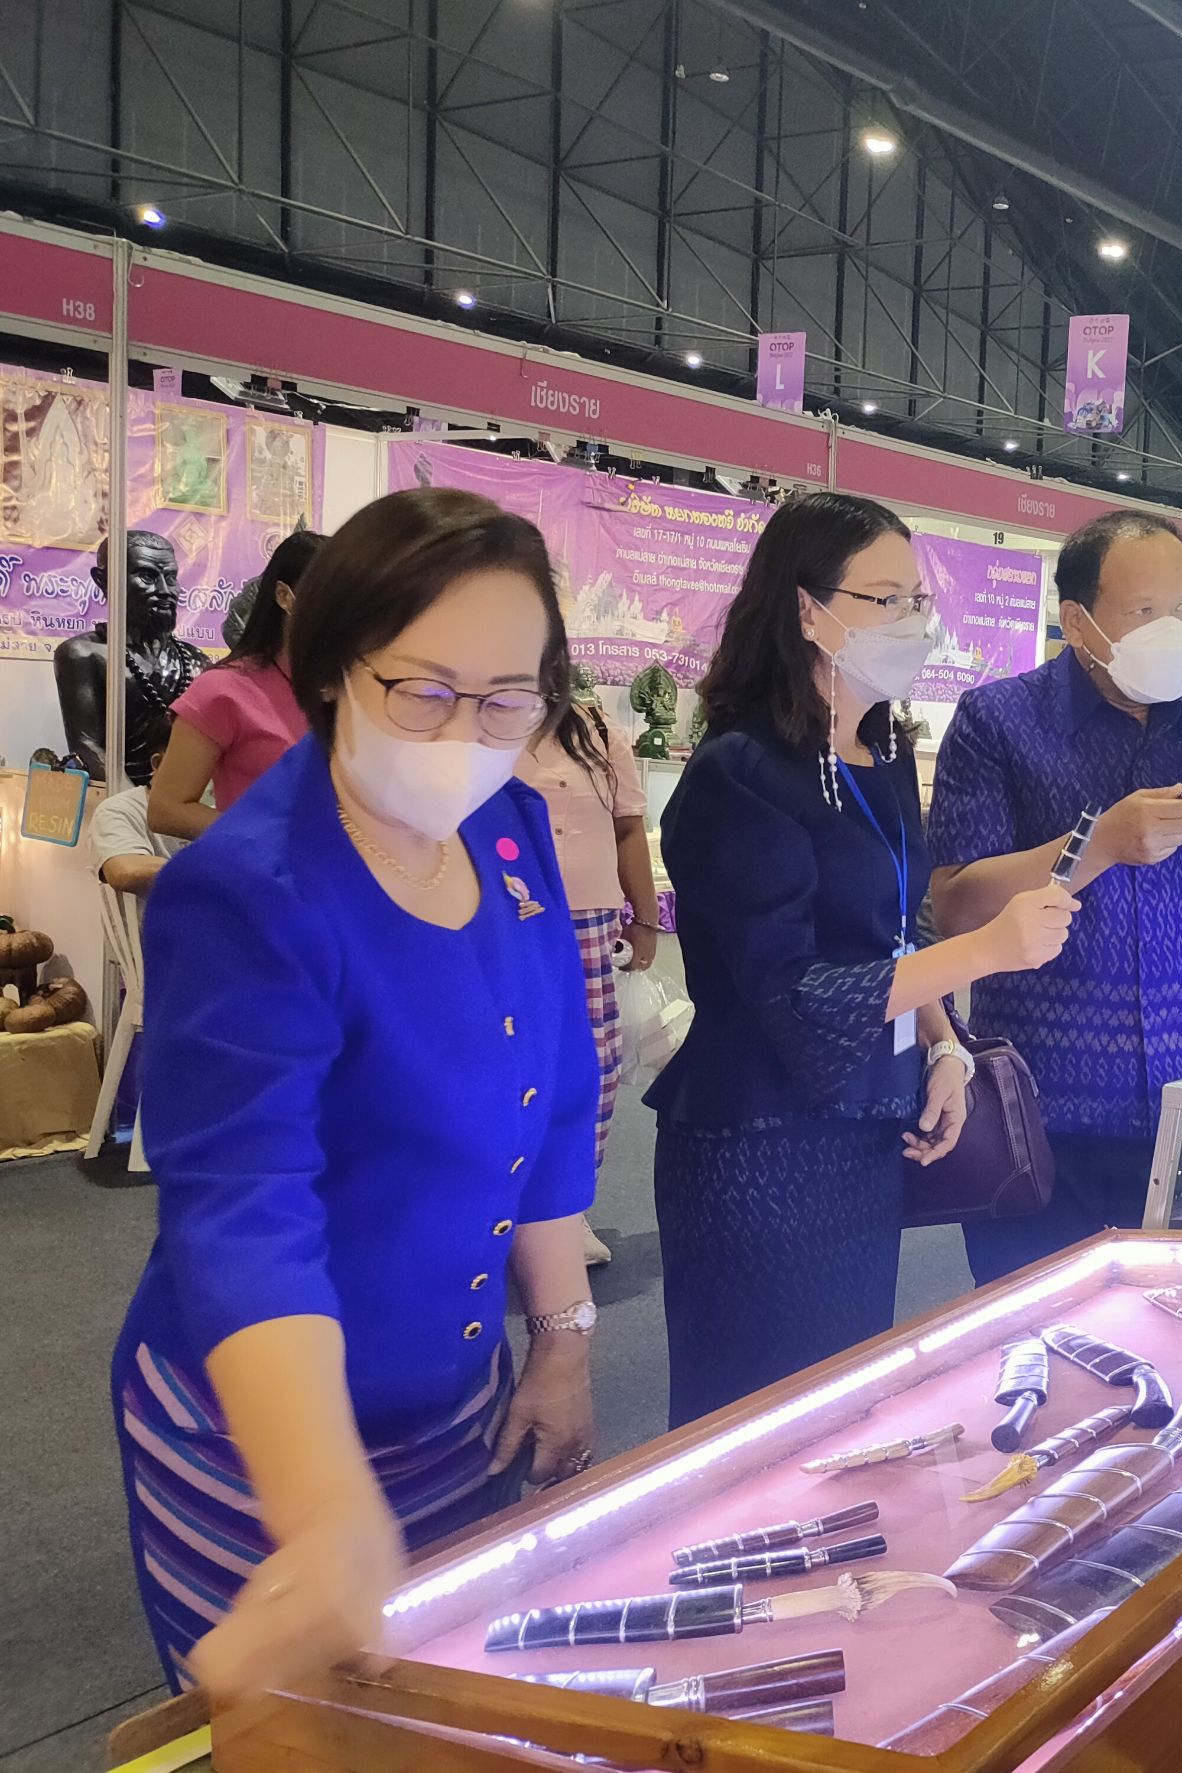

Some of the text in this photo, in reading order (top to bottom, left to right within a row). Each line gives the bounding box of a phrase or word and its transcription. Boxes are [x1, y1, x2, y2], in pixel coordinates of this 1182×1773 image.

[62, 298, 96, 321] H38
[1083, 325, 1114, 336] OTOP
[769, 342, 795, 352] OTOP
[1087, 349, 1107, 379] K
[775, 363, 785, 390] L
[530, 380, 600, 419] เชียงราย
[806, 462, 822, 477] H36
[1017, 493, 1056, 519] เชียงราย
[653, 528, 682, 545] 17-17/1
[696, 535, 706, 548] 10
[993, 531, 1005, 545] 19
[988, 593, 995, 604] 10
[30, 610, 85, 630] หินหยก
[571, 643, 595, 656] 013
[598, 640, 640, 657] โทรสาร
[921, 668, 975, 684] 084-504 6090
